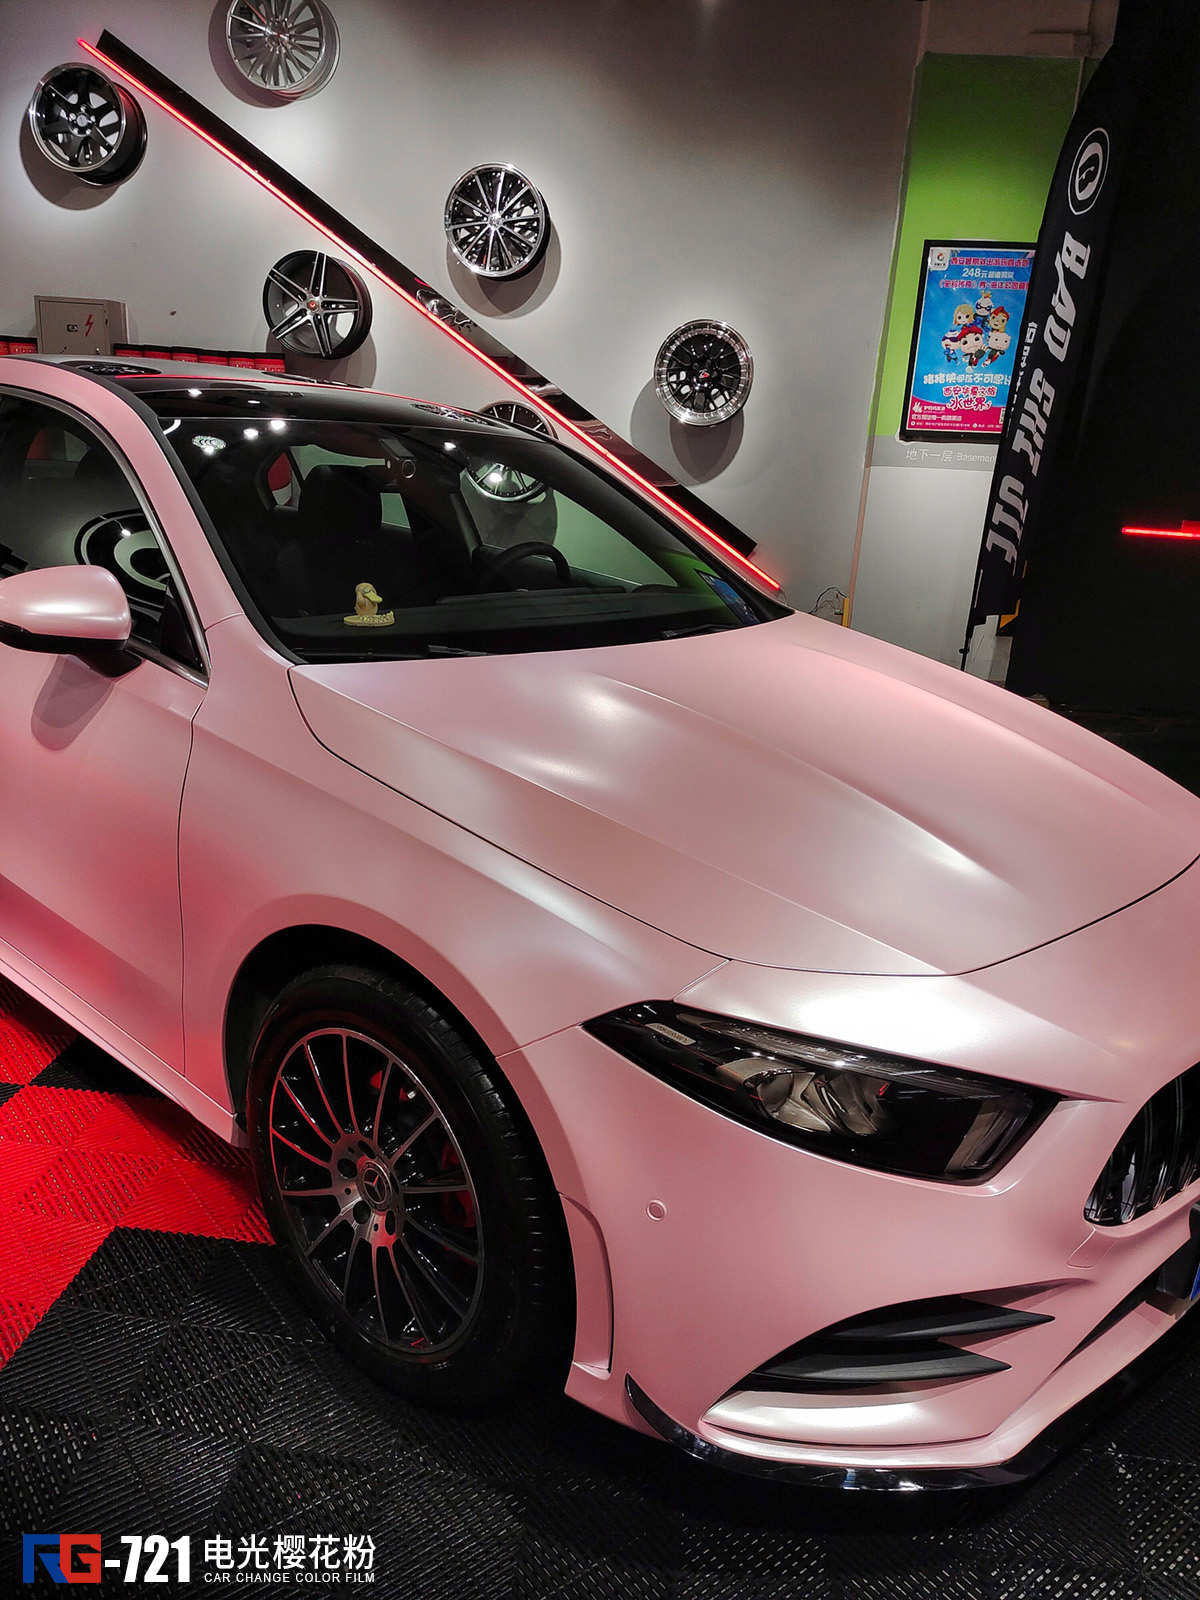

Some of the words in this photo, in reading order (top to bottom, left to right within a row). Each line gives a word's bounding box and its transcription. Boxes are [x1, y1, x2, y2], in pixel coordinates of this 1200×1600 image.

[946, 396, 992, 412] 水世界
[905, 448, 953, 462] 地下一层
[956, 452, 996, 463] Basemen
